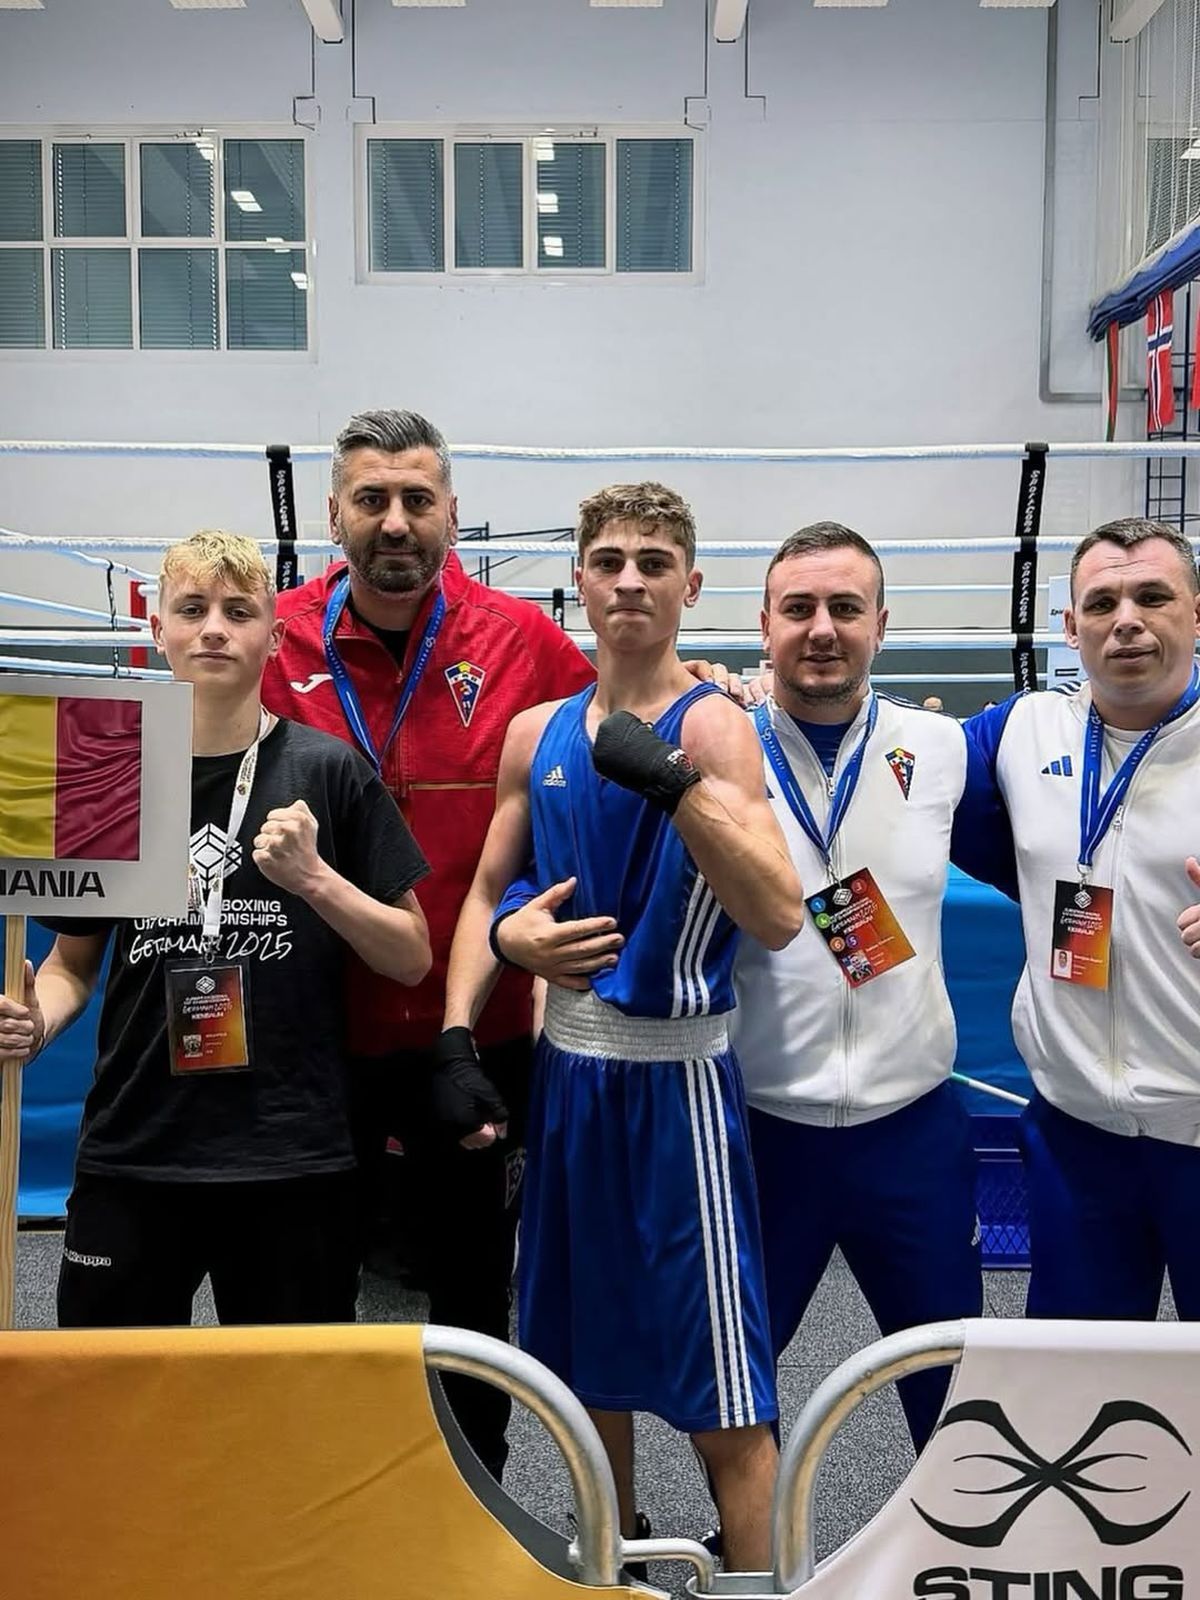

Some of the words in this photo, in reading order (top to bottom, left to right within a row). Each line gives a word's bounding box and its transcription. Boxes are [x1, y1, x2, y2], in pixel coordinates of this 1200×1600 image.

[221, 899, 281, 912] BOXING
[158, 913, 288, 927] CHAMONSHIPS
[226, 930, 293, 961] 2025
[913, 1565, 1184, 1600] STING
